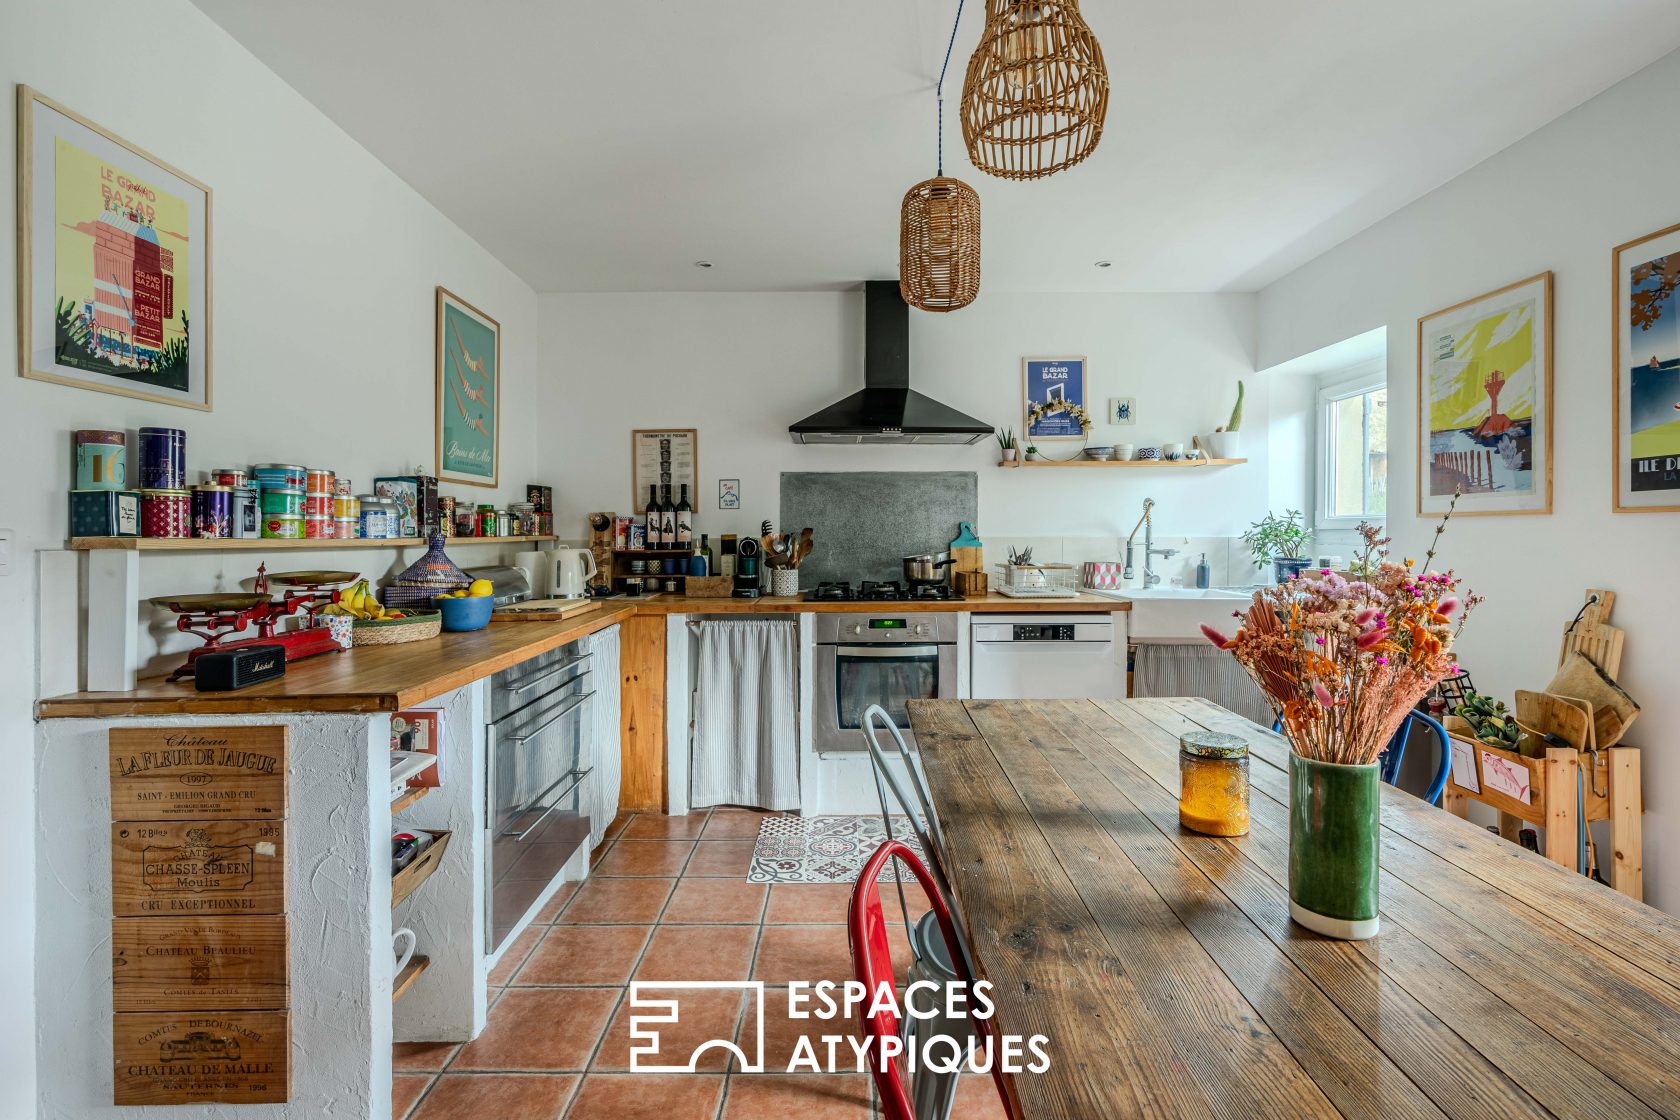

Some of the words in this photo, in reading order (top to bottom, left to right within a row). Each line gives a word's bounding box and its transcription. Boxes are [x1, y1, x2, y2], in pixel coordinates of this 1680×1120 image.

[101, 166, 113, 183] LE
[117, 175, 157, 203] GRAND
[102, 184, 155, 220] BAZAR
[134, 269, 160, 284] GRAND
[135, 276, 160, 291] BAZAR
[135, 309, 160, 323] BAZAR
[140, 304, 160, 317] PETIT
[468, 447, 475, 459] de
[1639, 458, 1660, 472] ILE
[252, 661, 274, 672] Marshall
[165, 734, 229, 747] Château
[116, 757, 142, 776] LA
[141, 749, 192, 772] FLEUR
[194, 749, 215, 766] DE
[218, 748, 277, 774] JAUGUE
[186, 776, 207, 784] 1997
[137, 792, 162, 801] SAINT
[170, 791, 205, 800] EMILION
[207, 791, 236, 799] GRAND
[238, 791, 256, 799] CRU
[137, 829, 147, 838] 12
[173, 849, 224, 862] CHATEAU
[146, 863, 250, 875] CHASSE-SPLEEN
[177, 877, 220, 888] Moulis
[141, 901, 161, 910] CRU
[171, 899, 256, 910] EXCEPTIONNEL
[146, 946, 198, 956] CHATEAU
[203, 945, 257, 955] BEAULIEU
[138, 1024, 177, 1045] COMTES
[189, 1019, 203, 1028] DE
[205, 1019, 263, 1042] BOURNAZEL
[128, 1064, 196, 1076] CHATEAU
[201, 1064, 220, 1075] DE
[224, 1063, 274, 1074] MALLE
